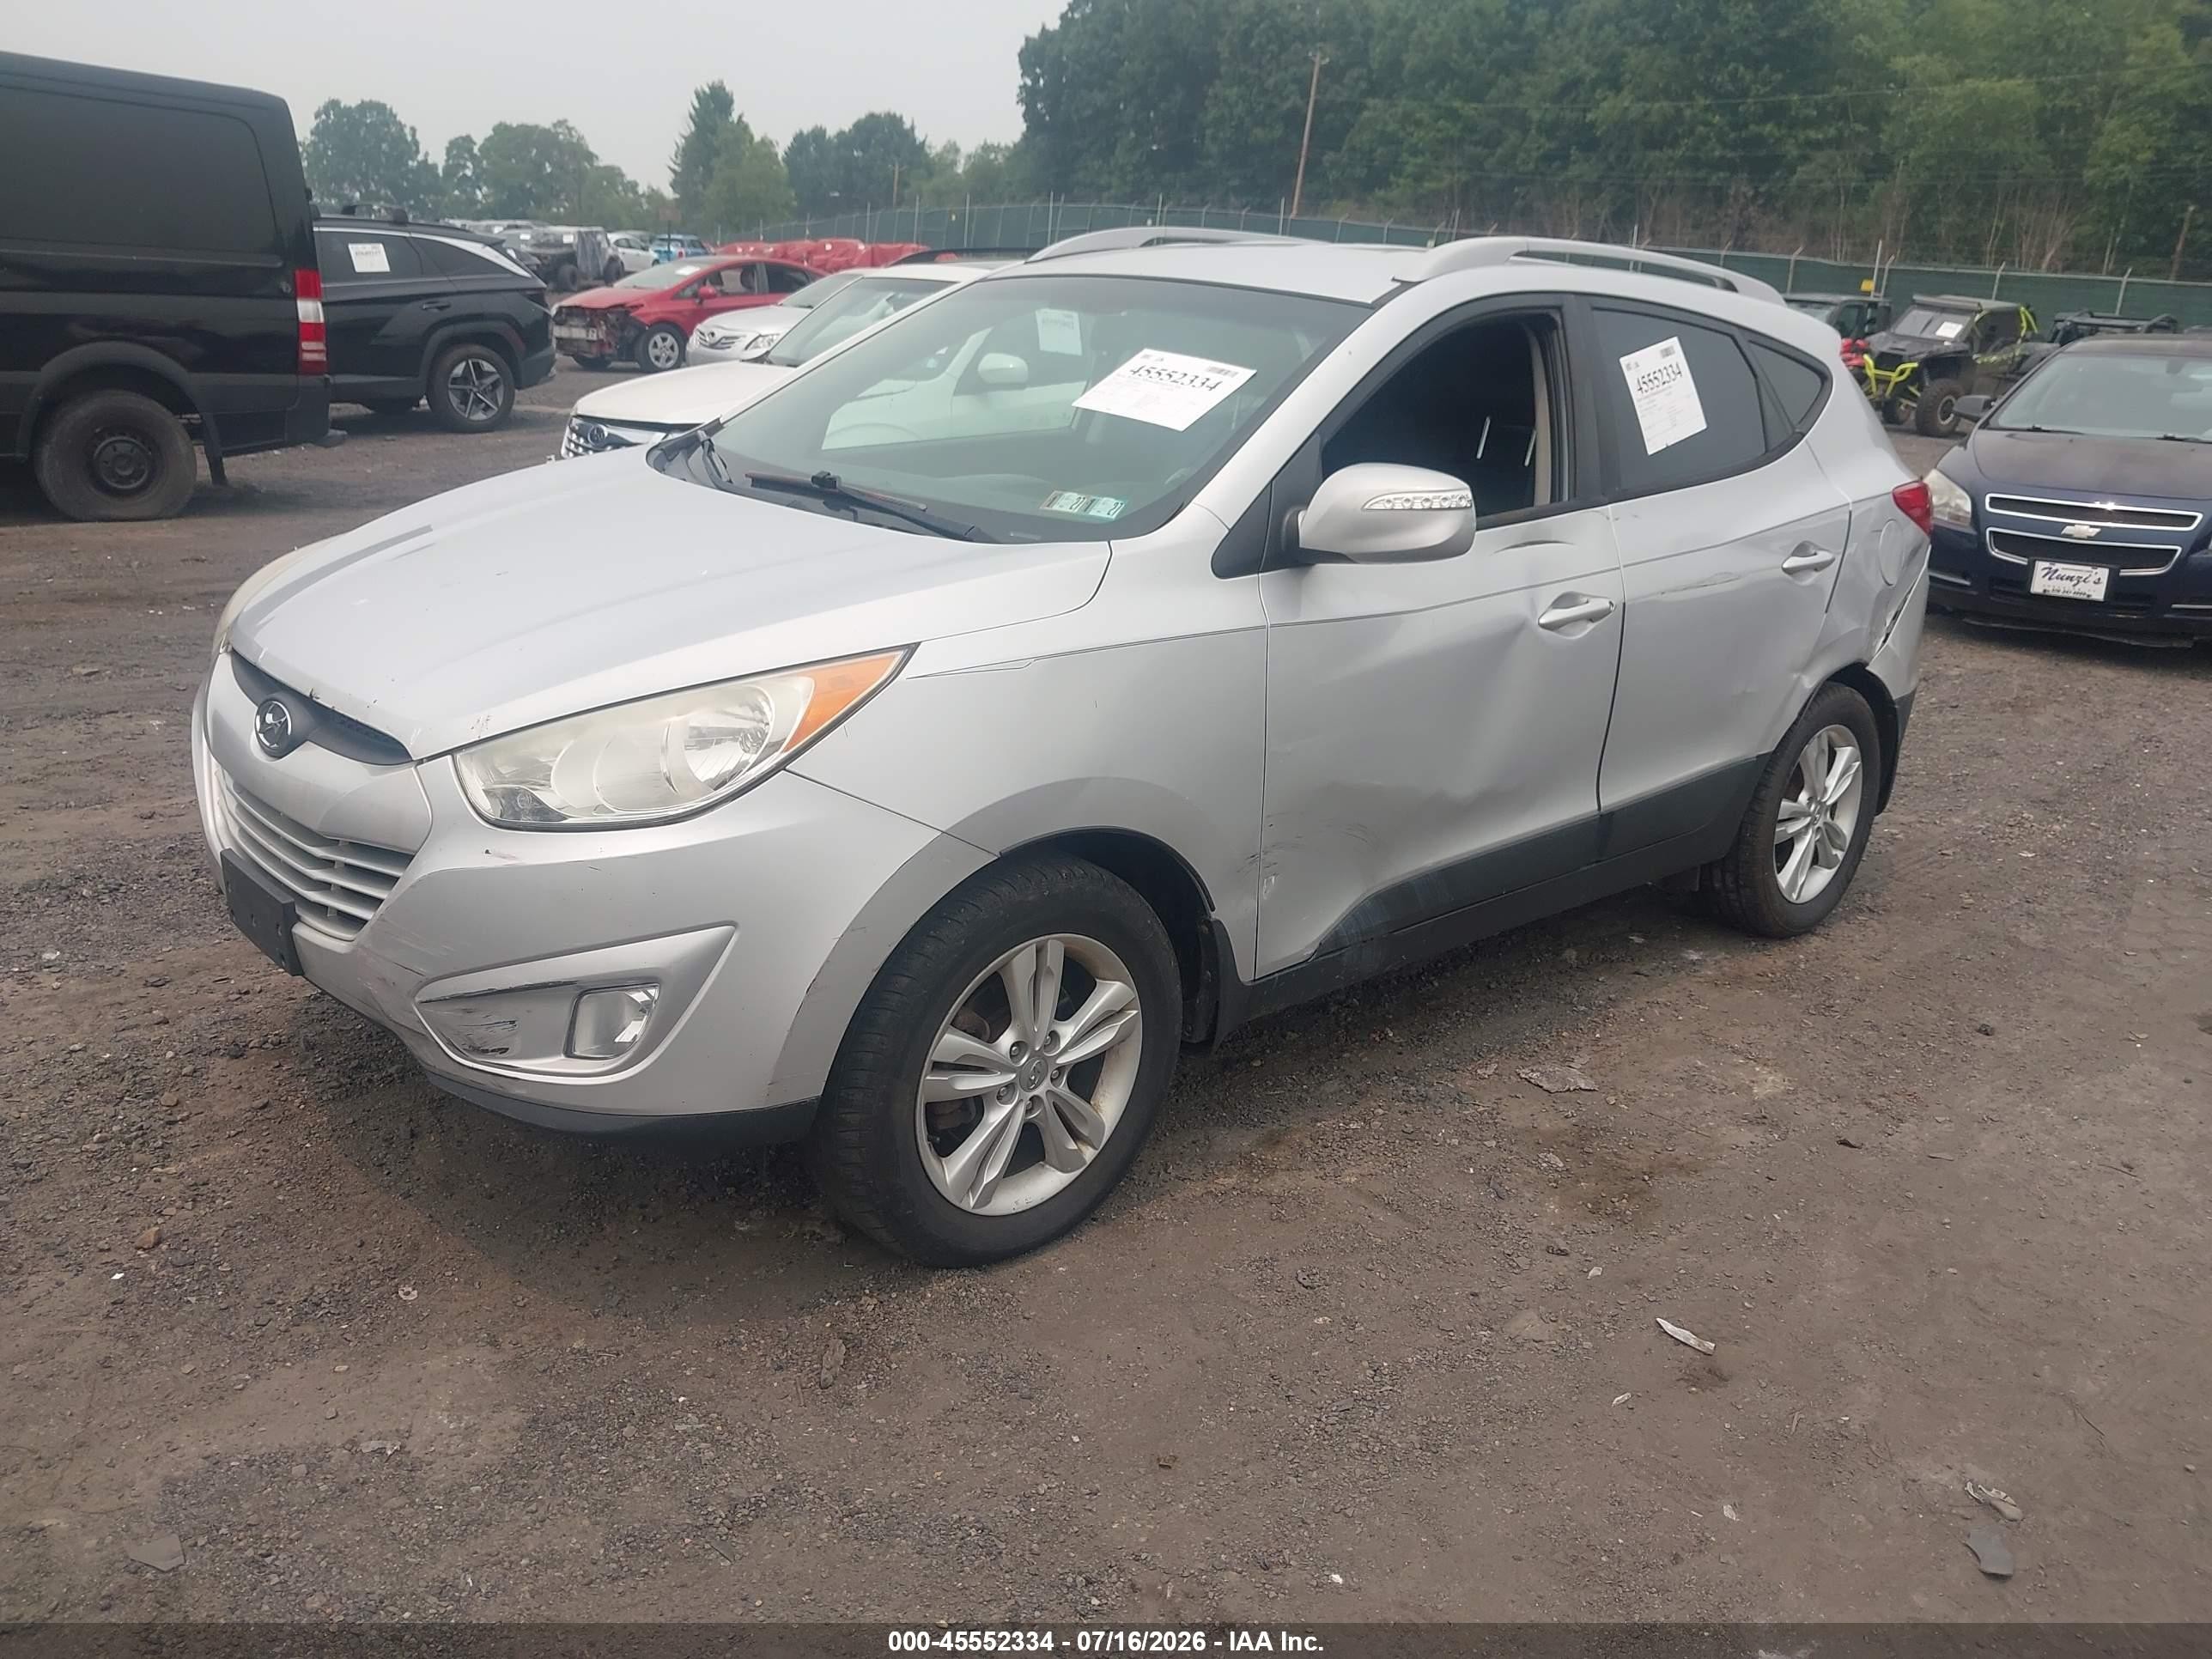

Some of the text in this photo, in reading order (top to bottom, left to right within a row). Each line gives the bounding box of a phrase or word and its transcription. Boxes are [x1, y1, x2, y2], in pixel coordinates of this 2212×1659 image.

[1129, 364, 1223, 392] 45552334
[1637, 362, 1683, 394] 45552334
[2041, 567, 2103, 587] Nunzi's
